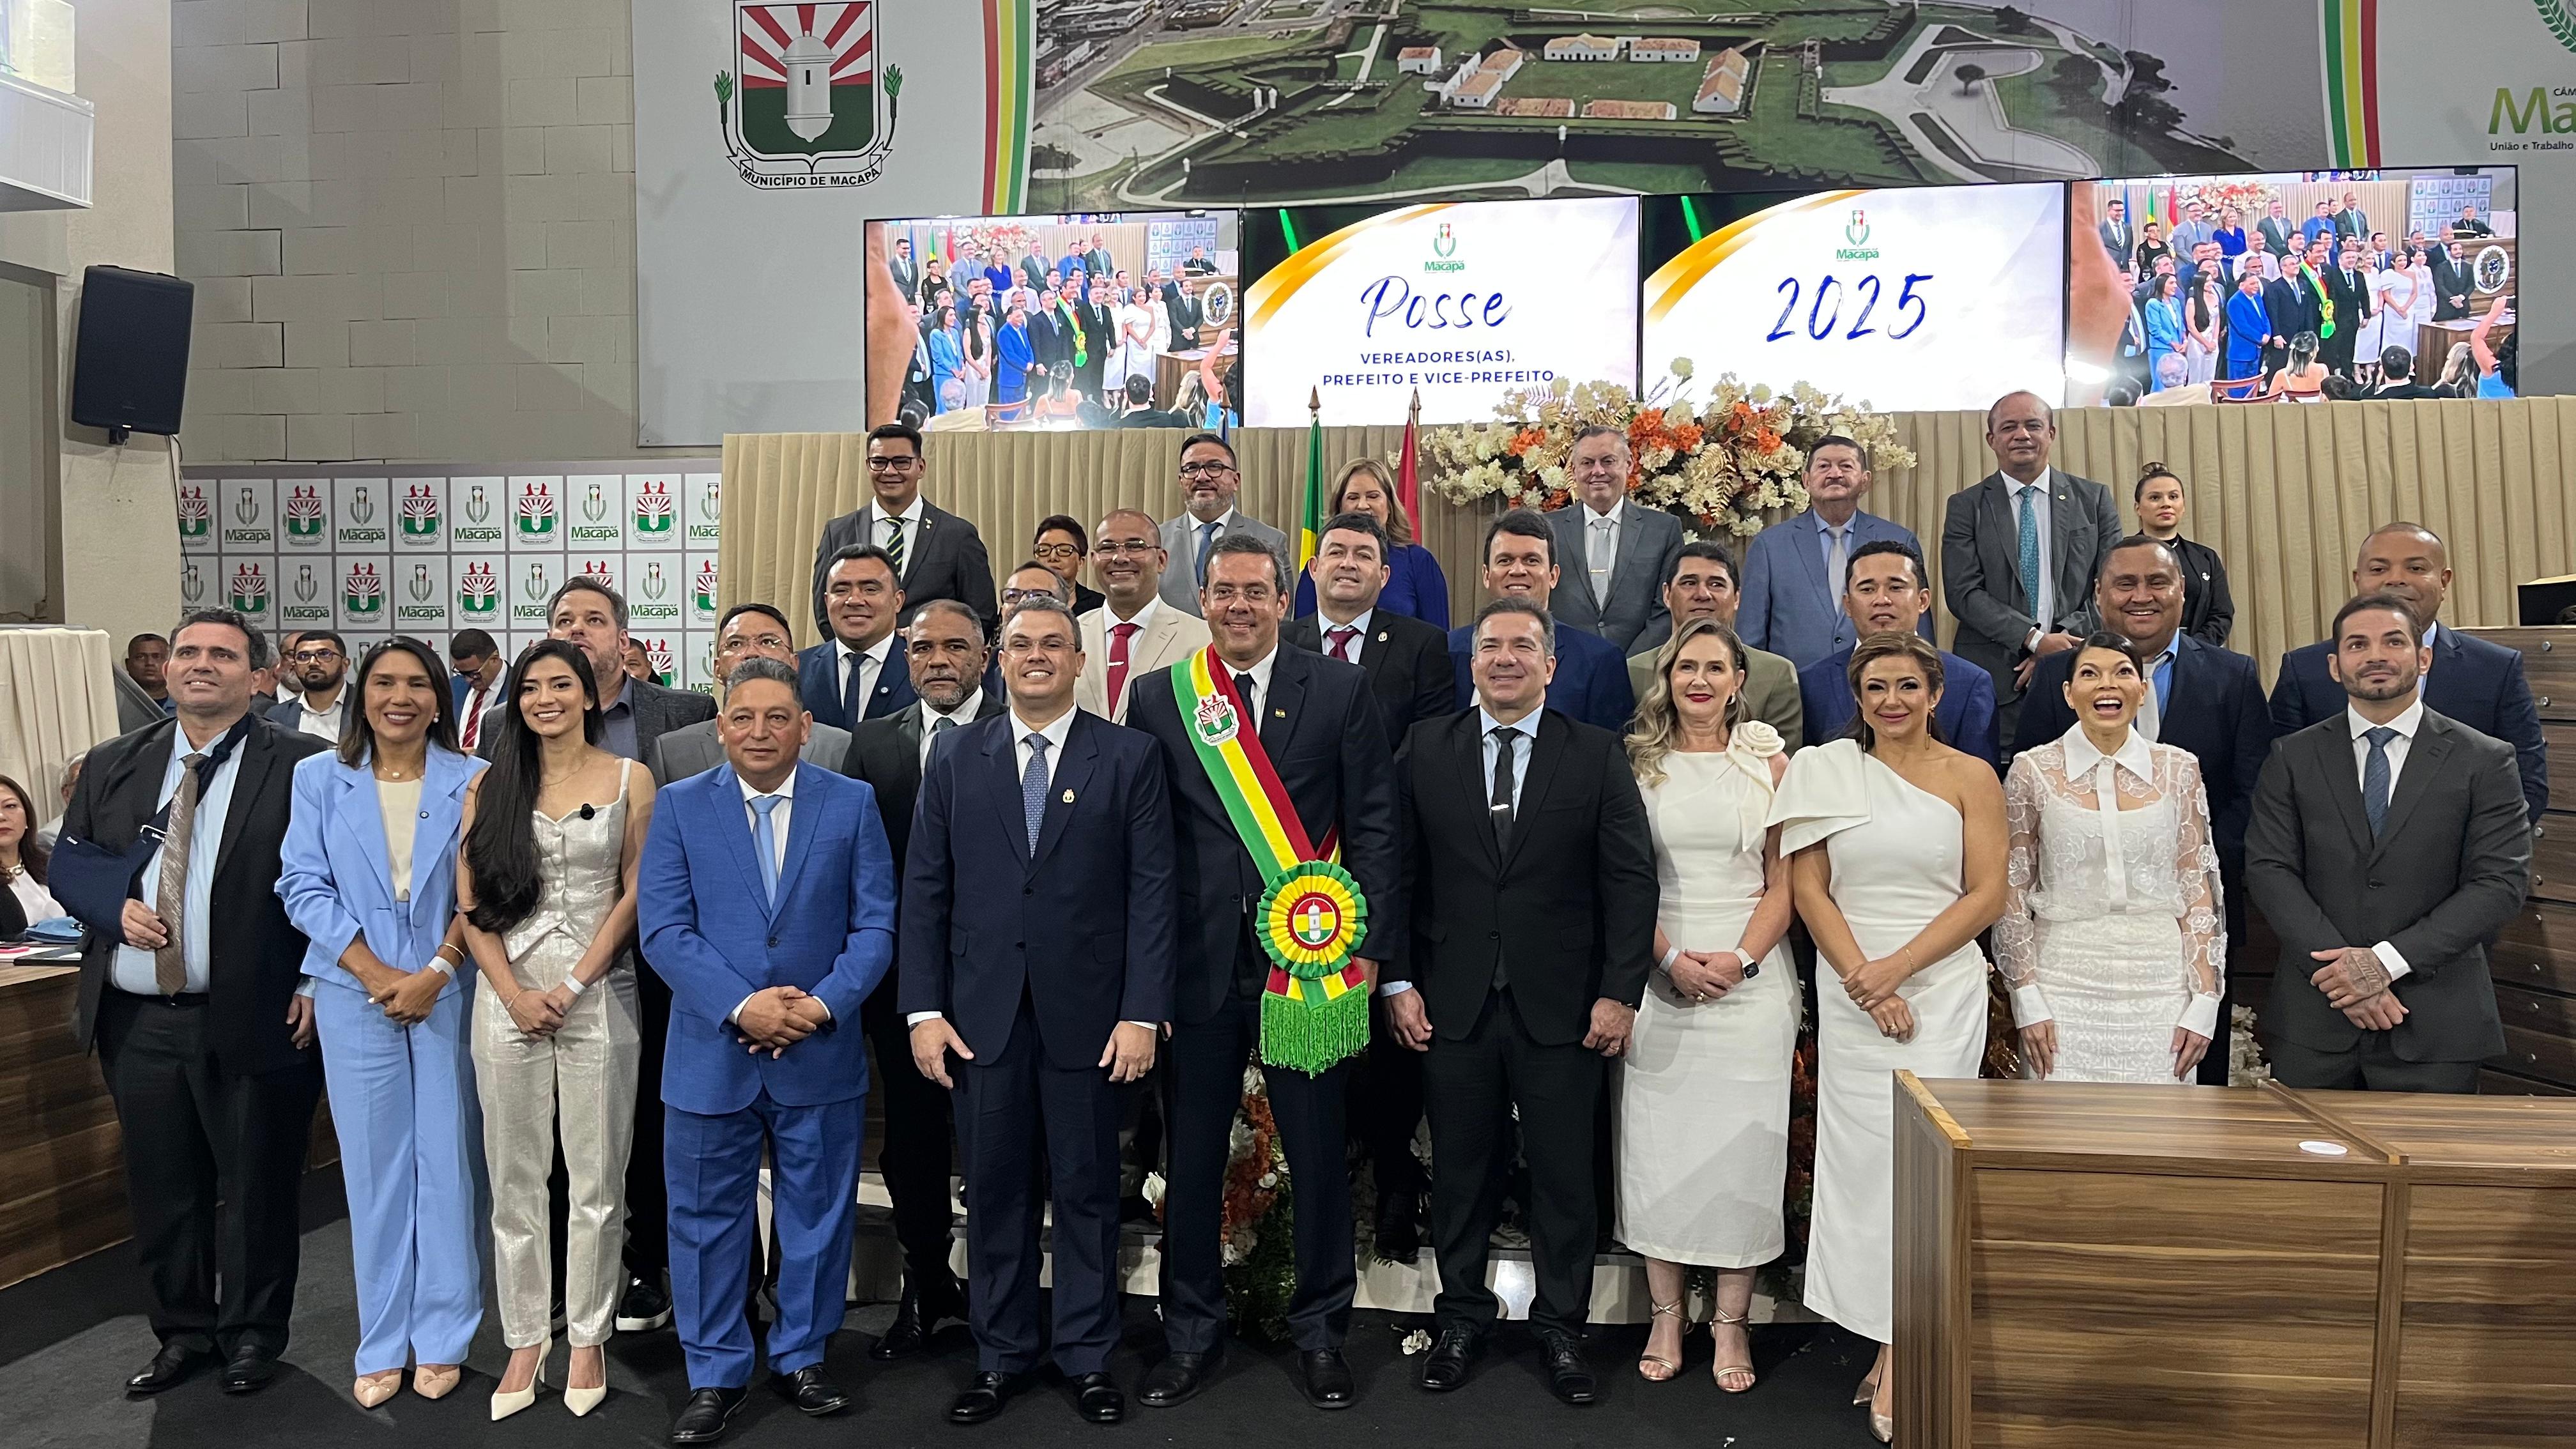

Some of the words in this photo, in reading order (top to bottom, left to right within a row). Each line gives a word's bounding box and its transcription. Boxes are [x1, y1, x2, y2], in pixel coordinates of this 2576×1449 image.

[2490, 142, 2519, 150] União
[2532, 141, 2574, 150] Trabalho
[742, 169, 806, 186] MUNICÍPIO
[810, 176, 826, 185] DE
[1837, 248, 1880, 262] Macapá
[1425, 259, 1465, 273] Macapá
[1360, 275, 1512, 338] Posse
[1766, 273, 1934, 342] 2025
[1360, 349, 1515, 365] VEREADORES(AS),
[1323, 373, 1404, 386] PREFEITO
[1409, 373, 1418, 385] E
[1425, 370, 1554, 384] VICE-PREFEITO
[226, 529, 271, 544] Macapá
[340, 528, 386, 543] Macapá
[455, 527, 502, 542] Macapá
[571, 526, 619, 541] Macapá
[690, 525, 719, 537] Maca
[284, 606, 330, 621] Macapá
[399, 605, 445, 620] Macapá
[514, 605, 546, 617] Maca
[631, 604, 678, 619] Macapá
